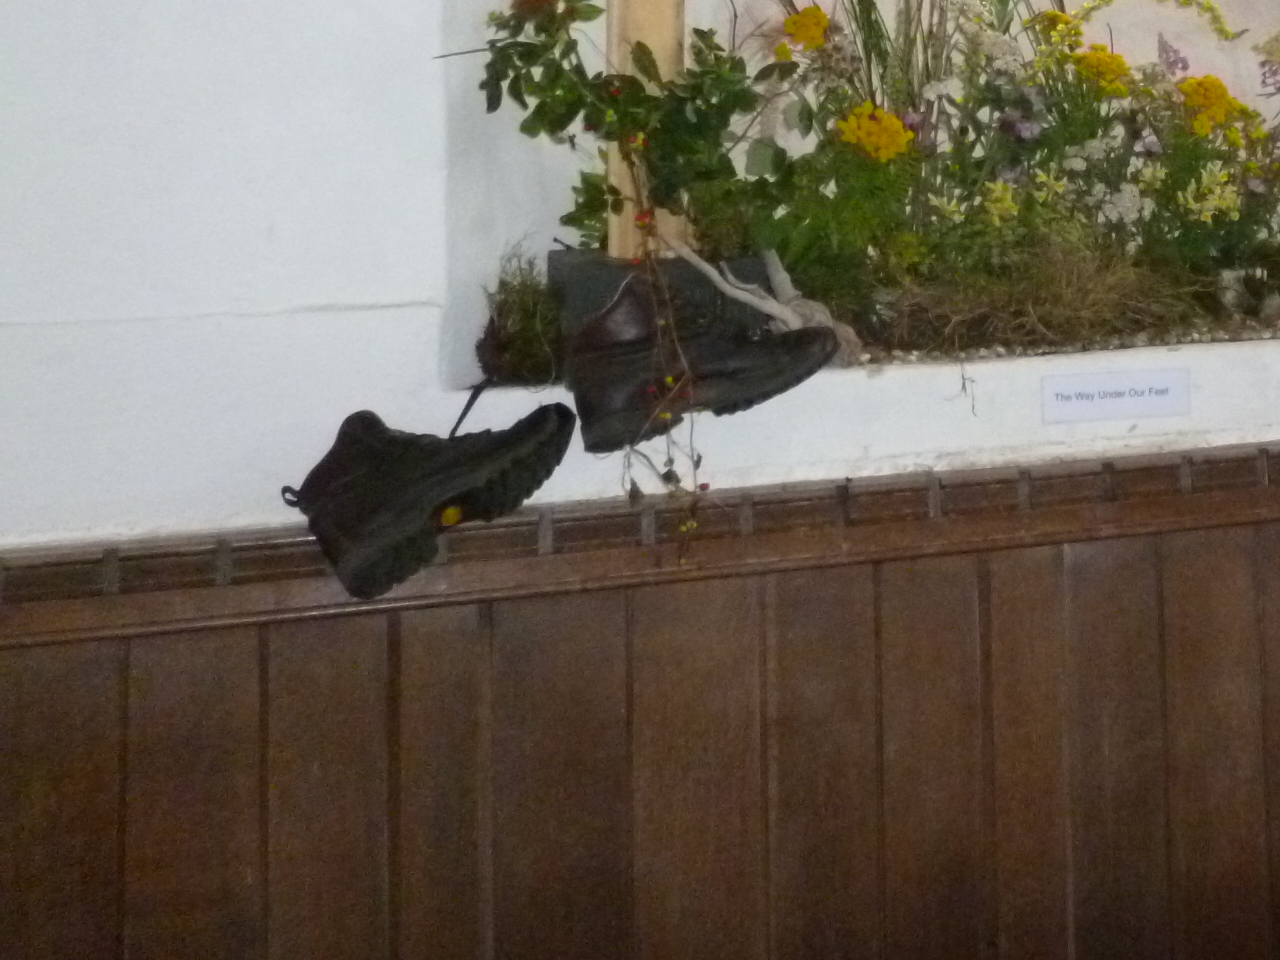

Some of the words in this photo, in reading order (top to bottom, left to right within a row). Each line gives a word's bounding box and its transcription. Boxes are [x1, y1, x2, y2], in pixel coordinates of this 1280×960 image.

[1055, 393, 1073, 402] The
[1075, 392, 1096, 402] Way
[1098, 390, 1126, 400] Under
[1129, 389, 1145, 398] Our
[1148, 387, 1169, 397] Feet
